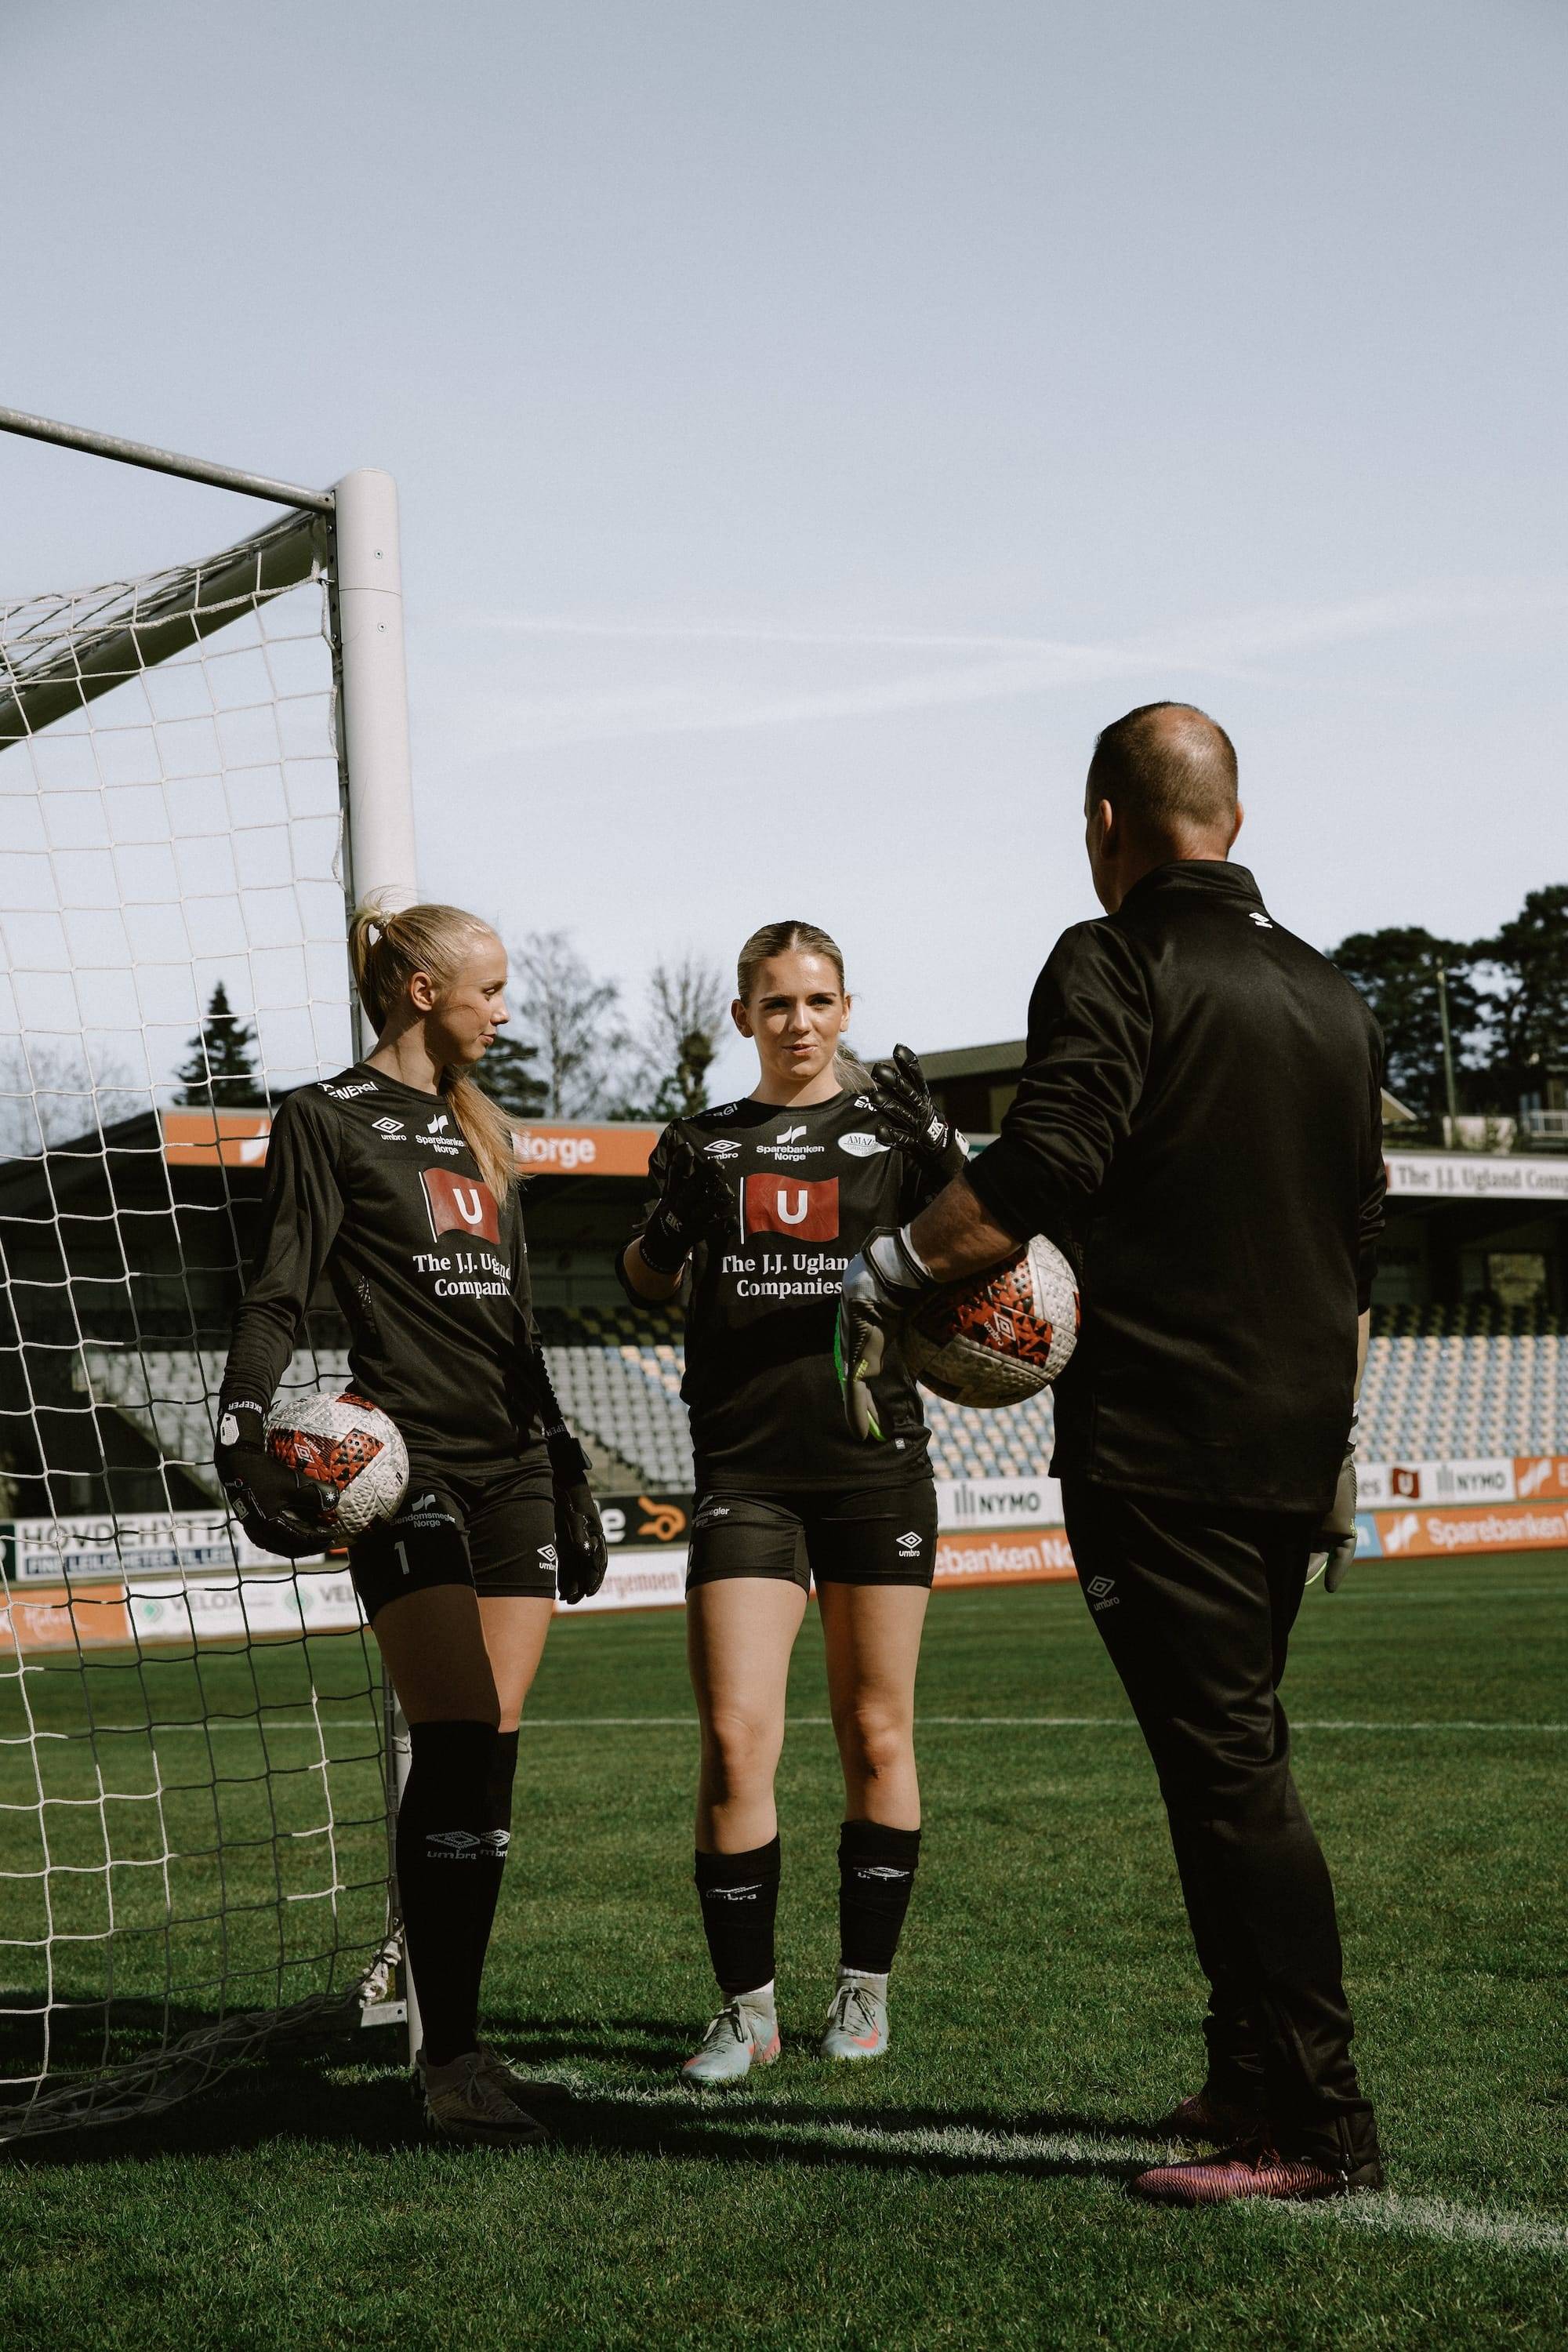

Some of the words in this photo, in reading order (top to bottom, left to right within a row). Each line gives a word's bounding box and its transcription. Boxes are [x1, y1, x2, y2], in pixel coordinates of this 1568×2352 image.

[416, 1134, 465, 1148] Sparebanke
[434, 1145, 459, 1156] Norge
[511, 1131, 596, 1169] Norge
[756, 1145, 825, 1154] Sparebanken
[775, 1153, 807, 1162] Norge
[452, 1189, 483, 1225] U
[777, 1189, 808, 1225] U
[413, 1254, 452, 1272] The
[456, 1254, 478, 1274] J.J.
[721, 1254, 756, 1273] The
[762, 1254, 788, 1275] J.J.
[793, 1254, 851, 1276] Uglan
[434, 1278, 511, 1299] Compani
[737, 1278, 843, 1300] Companies
[983, 1320, 1004, 1347] umbro
[303, 1436, 321, 1455] umbro
[1457, 1472, 1506, 1490] NYMO
[980, 1492, 1041, 1513] NYMO
[413, 1518, 441, 1528] Norge
[1427, 1514, 1563, 1550] Sparebanken
[394, 1541, 410, 1575] 1
[898, 1548, 920, 1558] umbro
[1094, 1595, 1120, 1612] umbro
